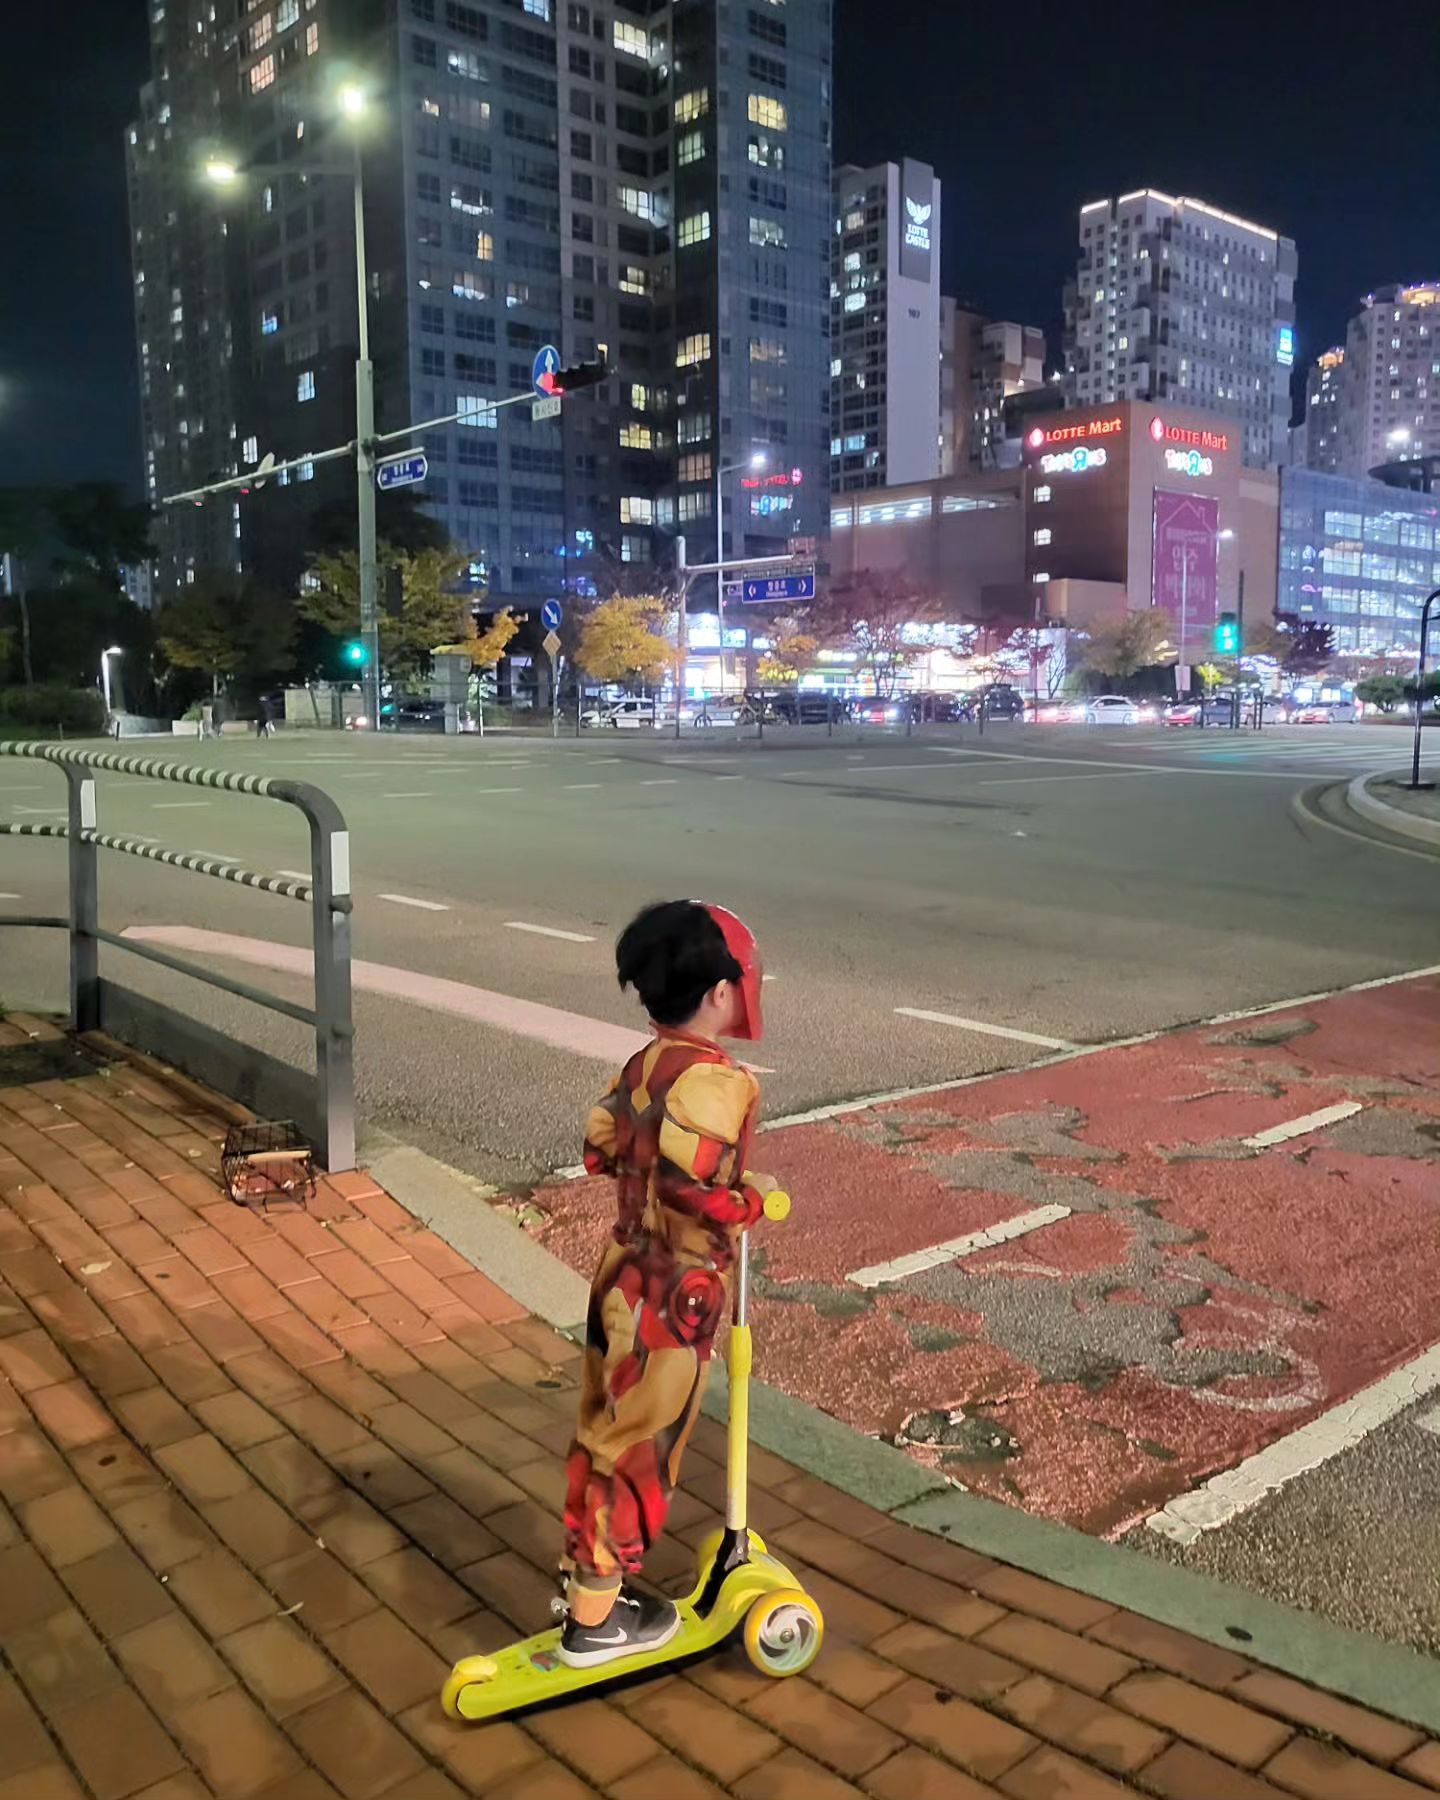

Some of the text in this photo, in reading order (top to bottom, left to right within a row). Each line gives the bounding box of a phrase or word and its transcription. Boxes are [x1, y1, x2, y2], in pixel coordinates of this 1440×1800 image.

[908, 223, 929, 238] LOTTE
[905, 233, 930, 249] CASTLE
[1046, 418, 1122, 442] LOTTE Mart
[1166, 427, 1227, 450] LOTTE Mart
